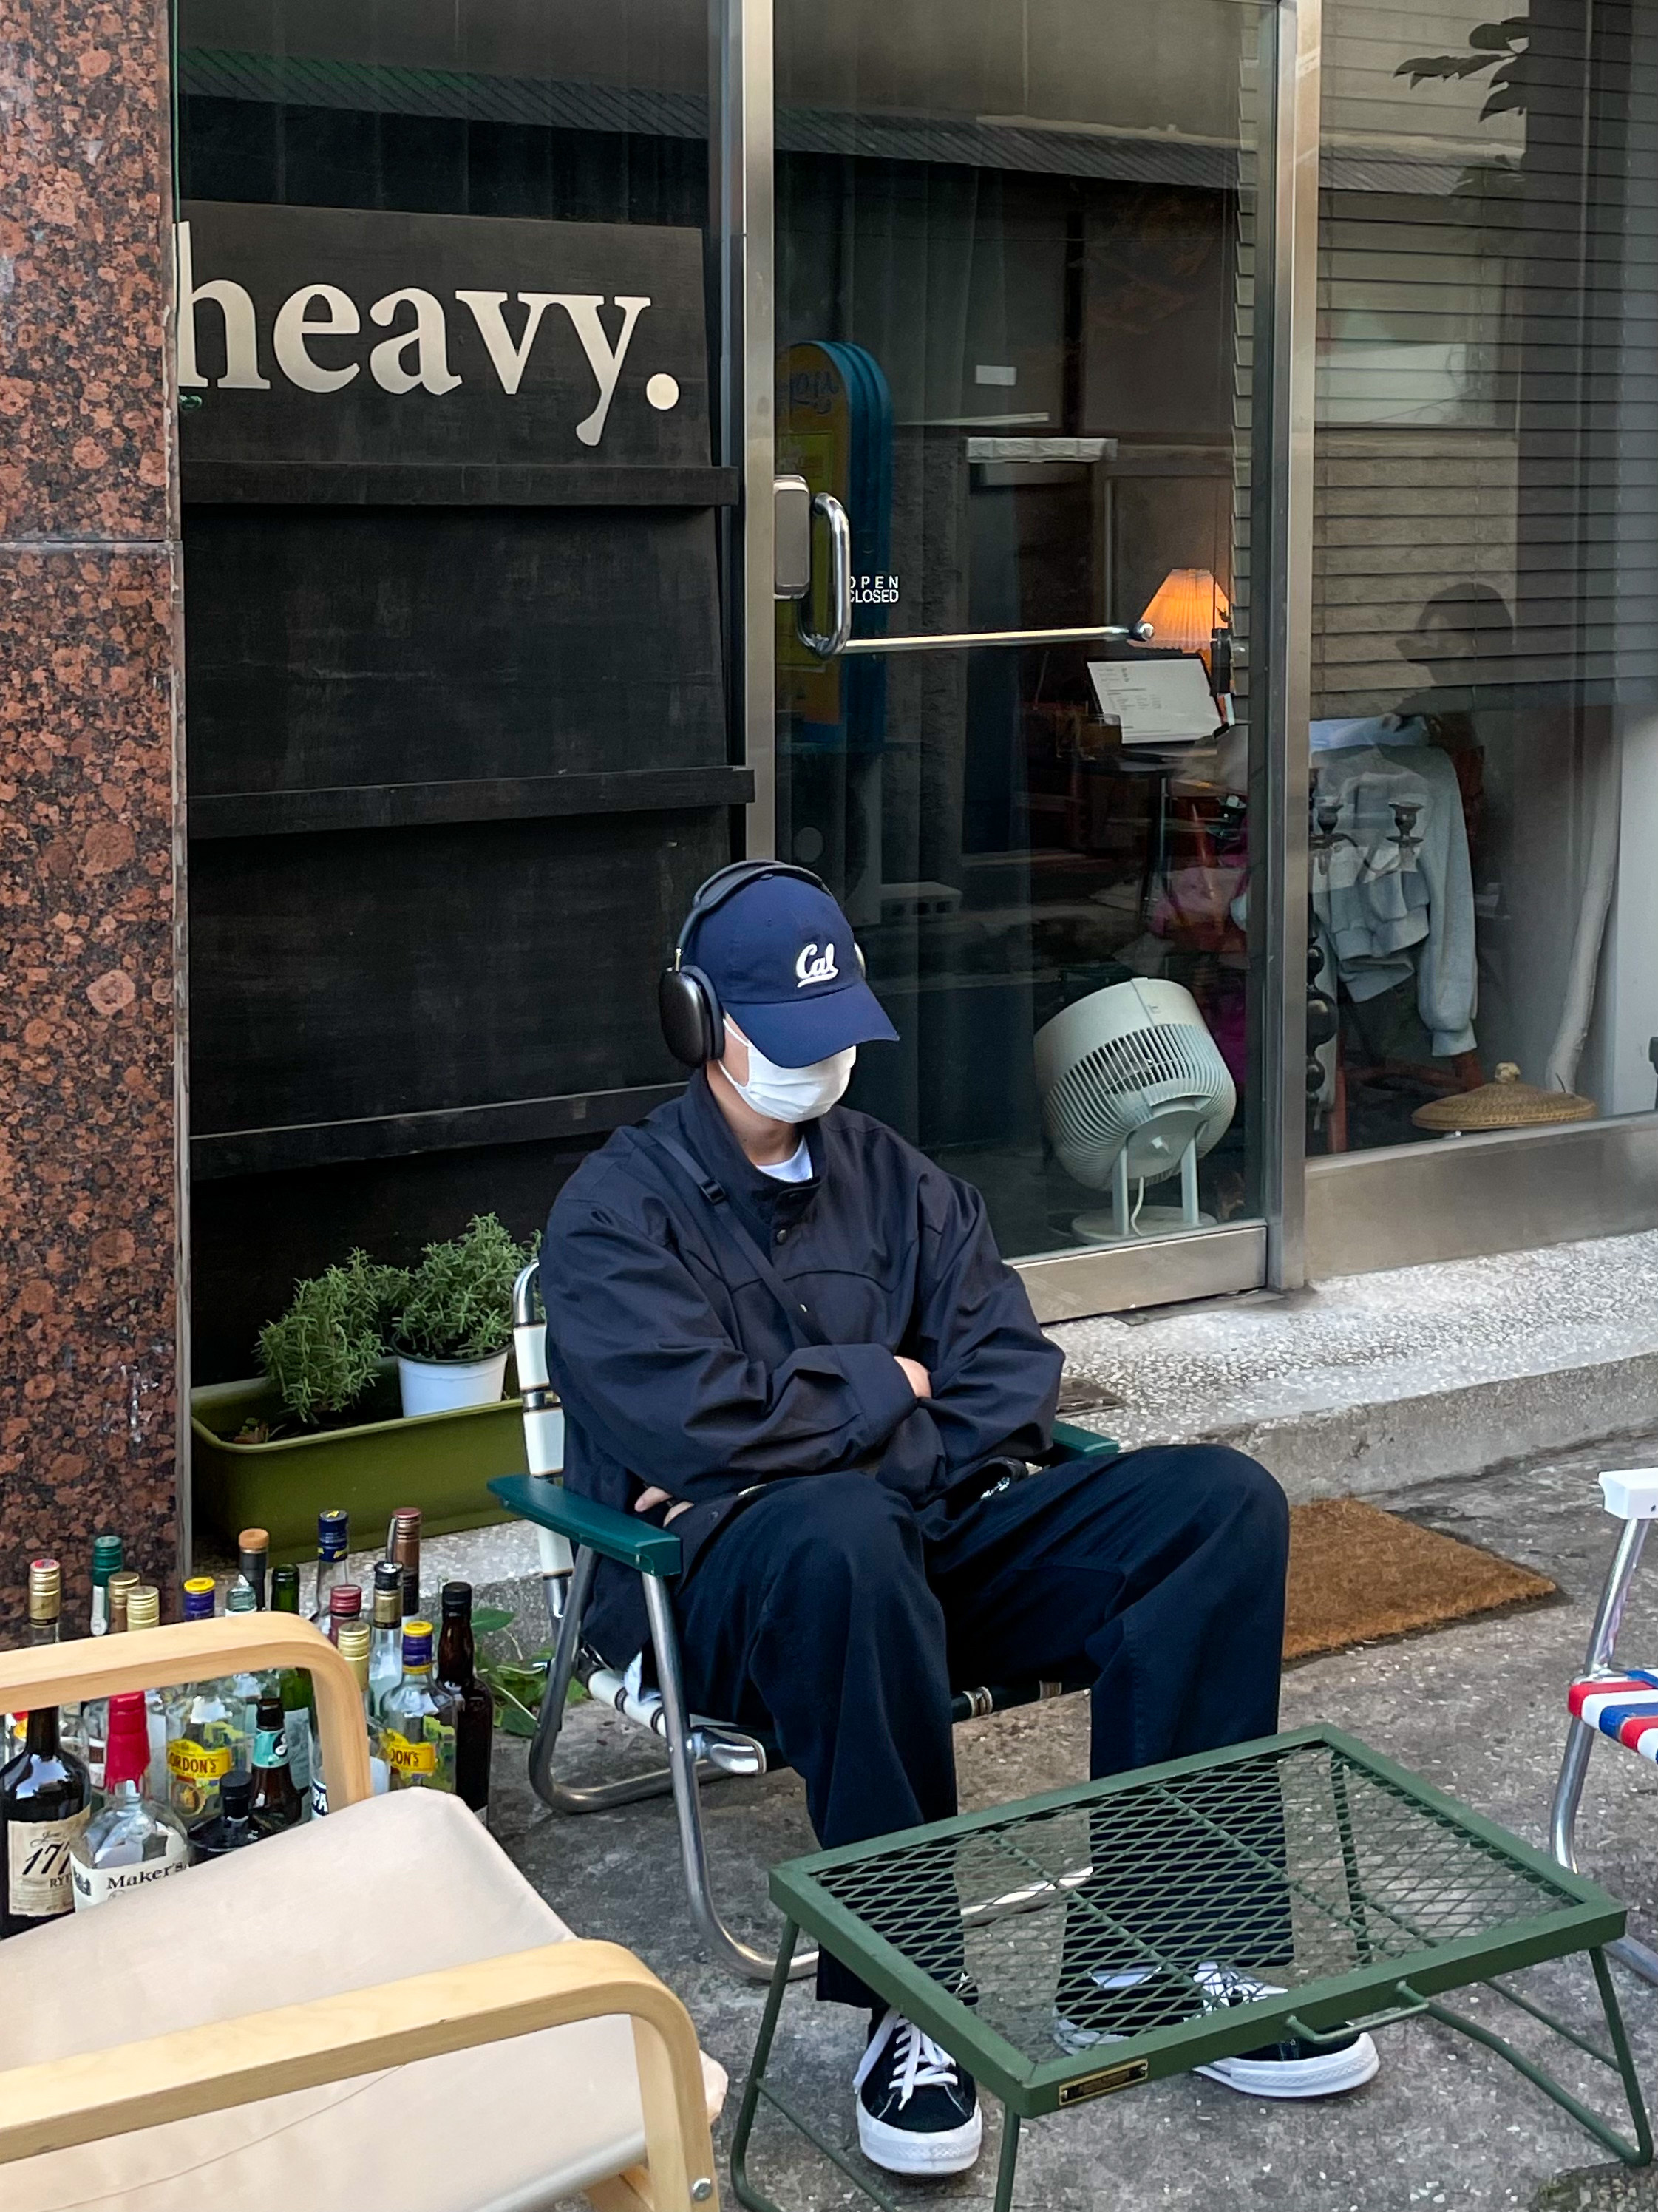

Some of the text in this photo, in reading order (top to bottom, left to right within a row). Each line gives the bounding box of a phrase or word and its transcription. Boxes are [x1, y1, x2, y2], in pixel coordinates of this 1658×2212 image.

[172, 220, 679, 446] heavy.
[795, 943, 839, 988] Cal
[169, 1751, 217, 1774] ORDON'S
[106, 1861, 185, 1890] Maker's
